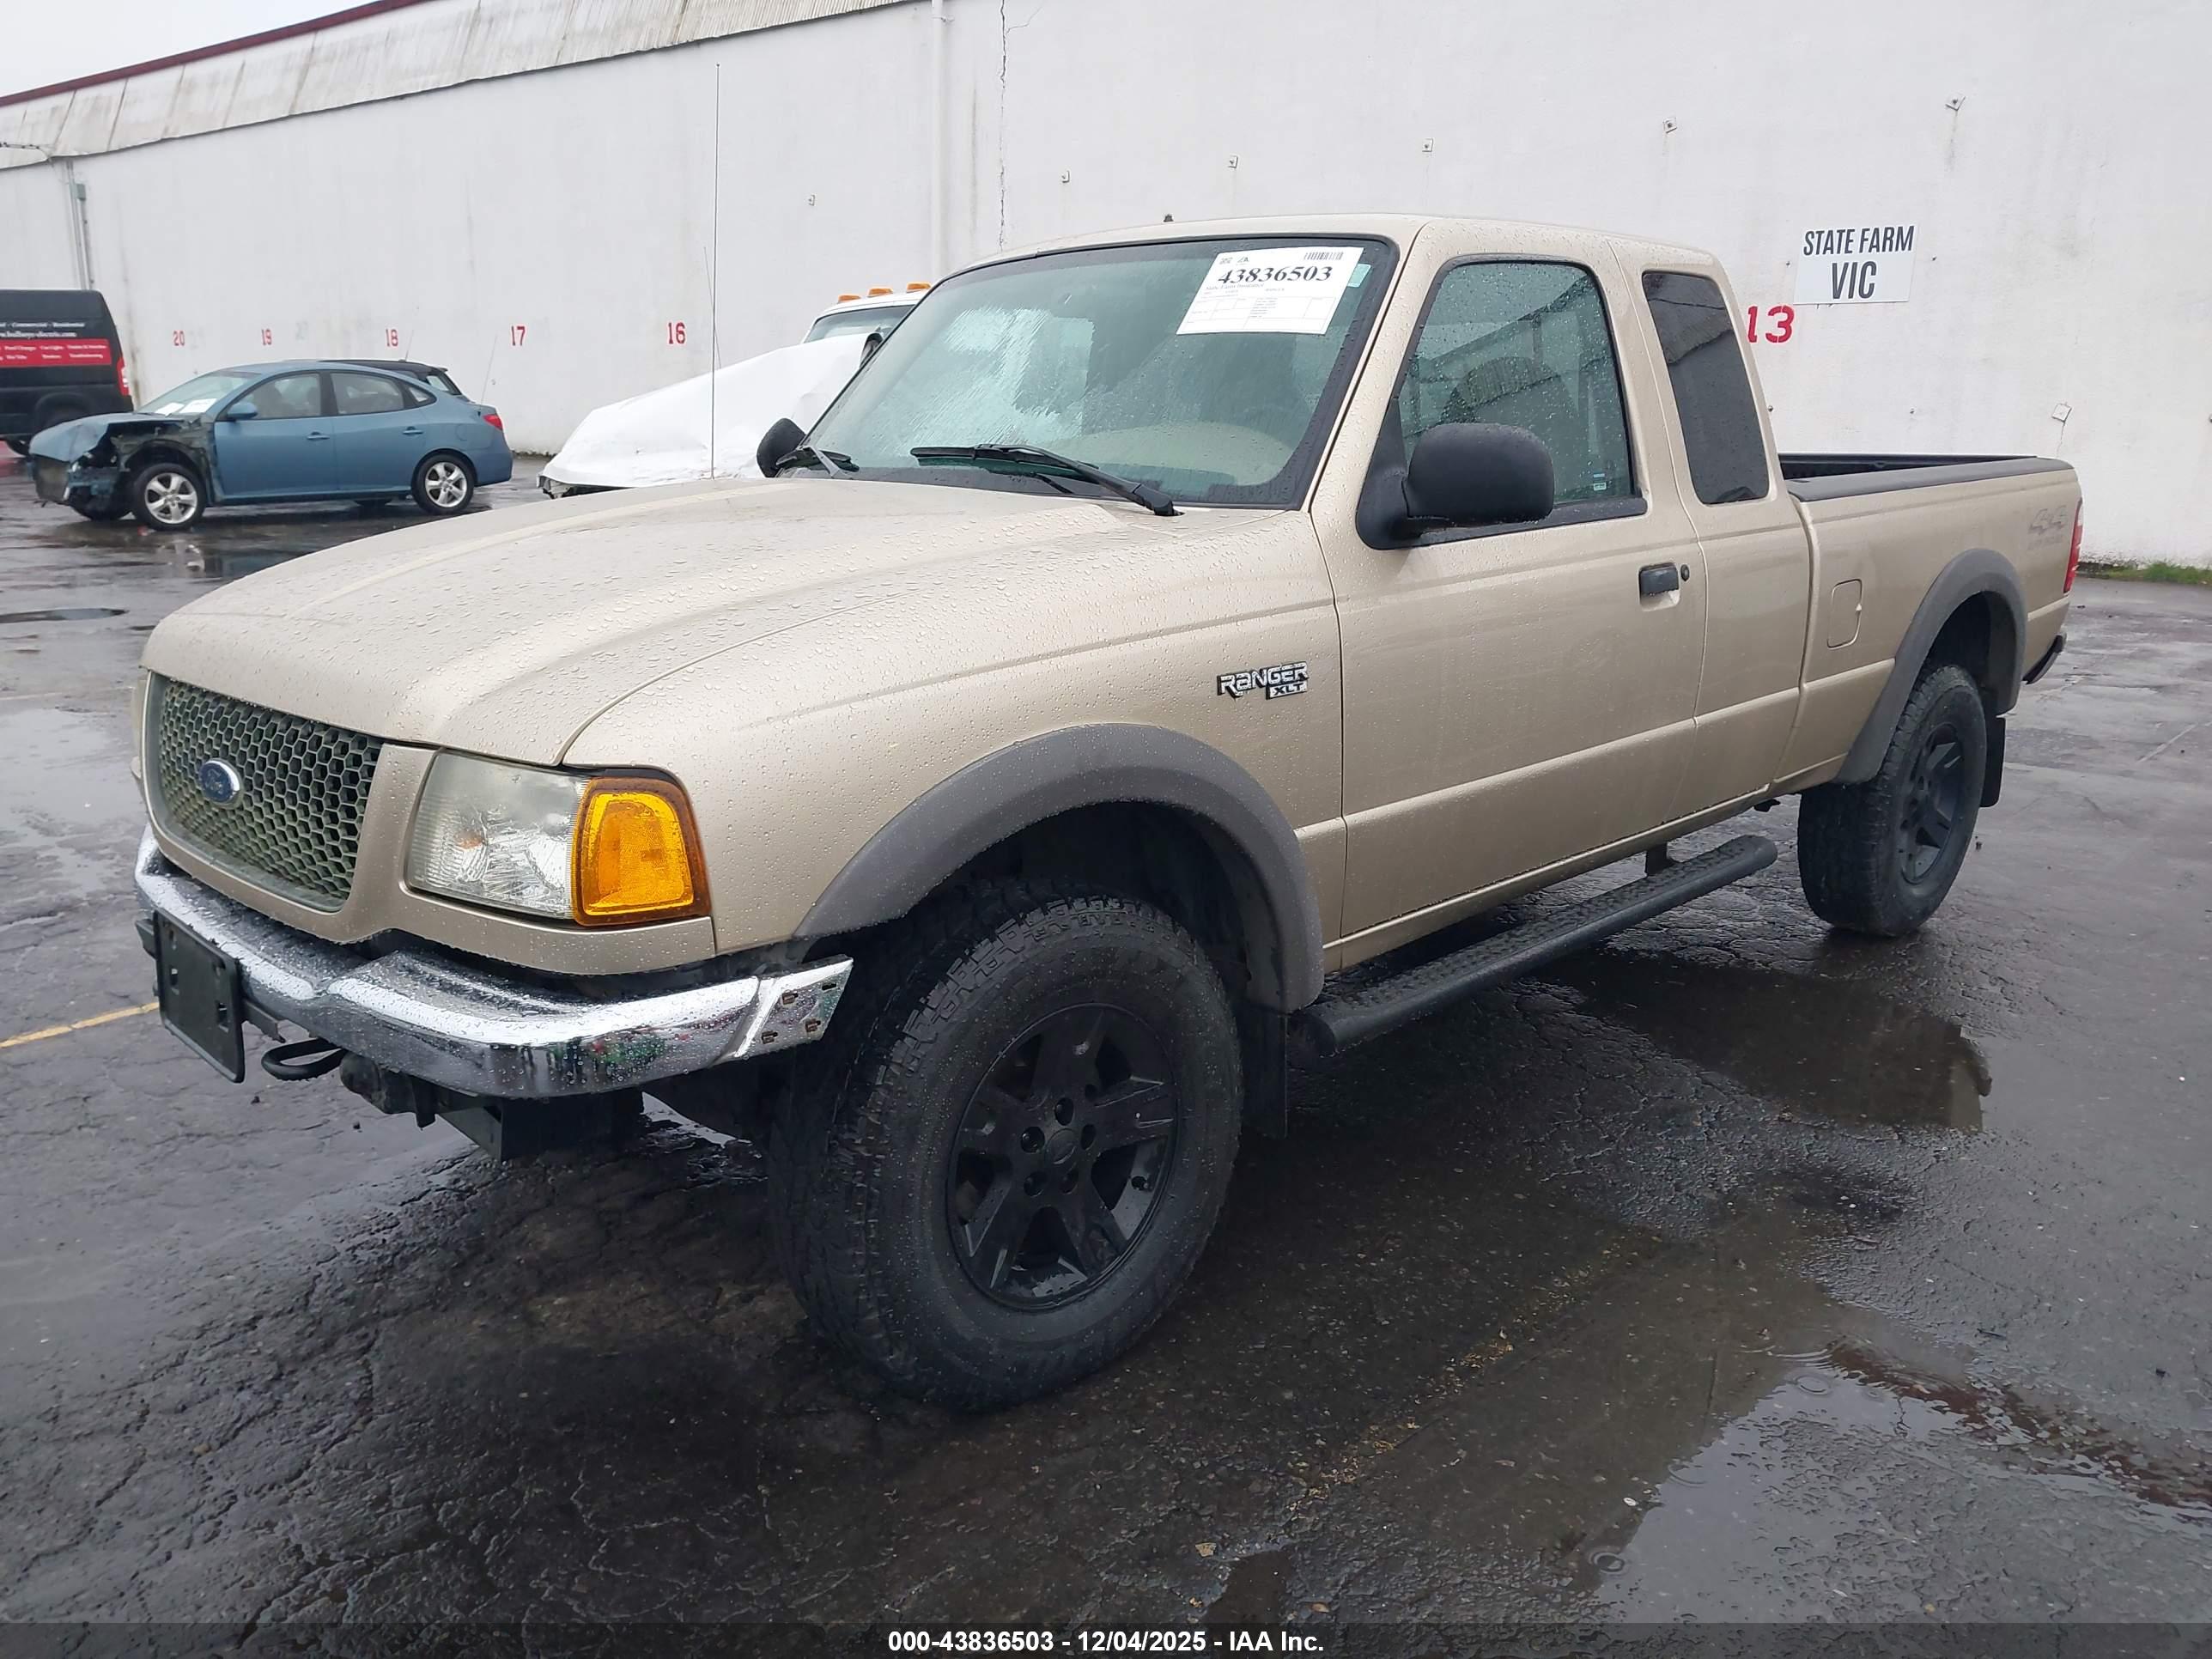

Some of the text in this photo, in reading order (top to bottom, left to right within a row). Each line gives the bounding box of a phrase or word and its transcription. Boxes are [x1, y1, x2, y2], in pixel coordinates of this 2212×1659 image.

[1803, 225, 1915, 256] STATE FARM
[1218, 265, 1333, 284] 43836503
[1831, 261, 1877, 300] VIC
[668, 322, 686, 344] 16
[1747, 305, 1795, 343] 13
[173, 330, 185, 346] 20
[261, 329, 272, 345] 19
[386, 329, 398, 347] 18
[511, 325, 526, 346] 17
[1217, 661, 1310, 698] RANGER
[1270, 681, 1307, 697] XLT
